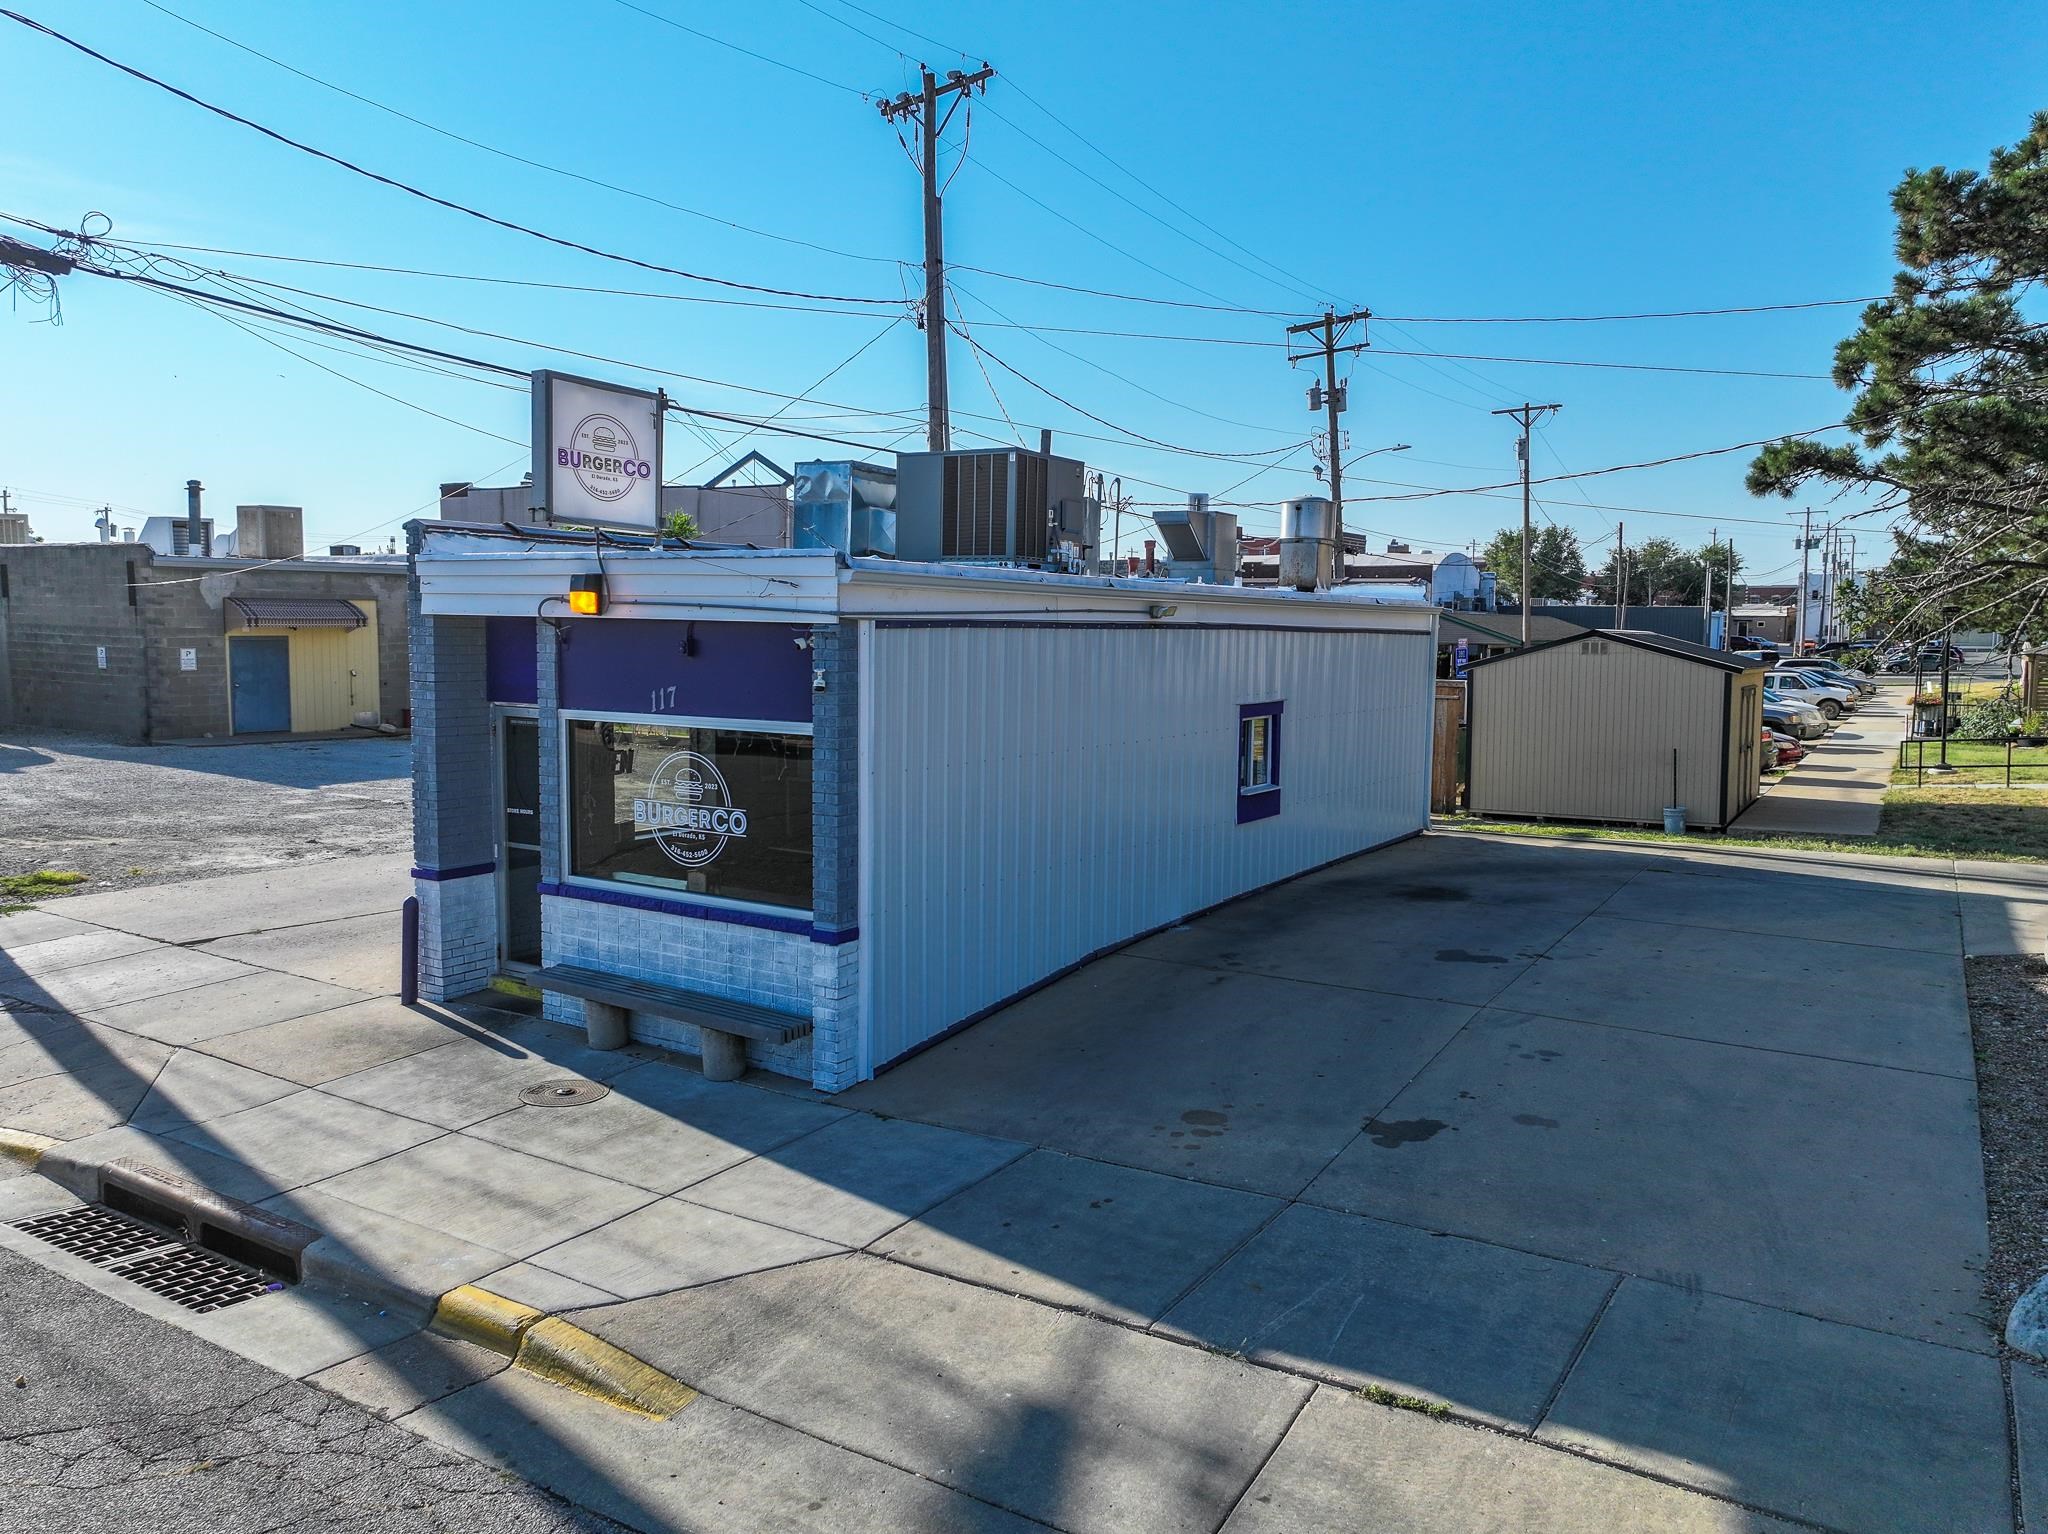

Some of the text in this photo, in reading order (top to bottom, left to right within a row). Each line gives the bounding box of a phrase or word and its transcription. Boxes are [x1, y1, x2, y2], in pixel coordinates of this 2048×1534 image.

[558, 448, 650, 478] BURGERCO
[651, 685, 677, 713] 117
[661, 778, 718, 791] EST. 2023
[634, 799, 747, 835] BURGERCO
[678, 831, 698, 841] Dorado,
[698, 833, 706, 841] KS
